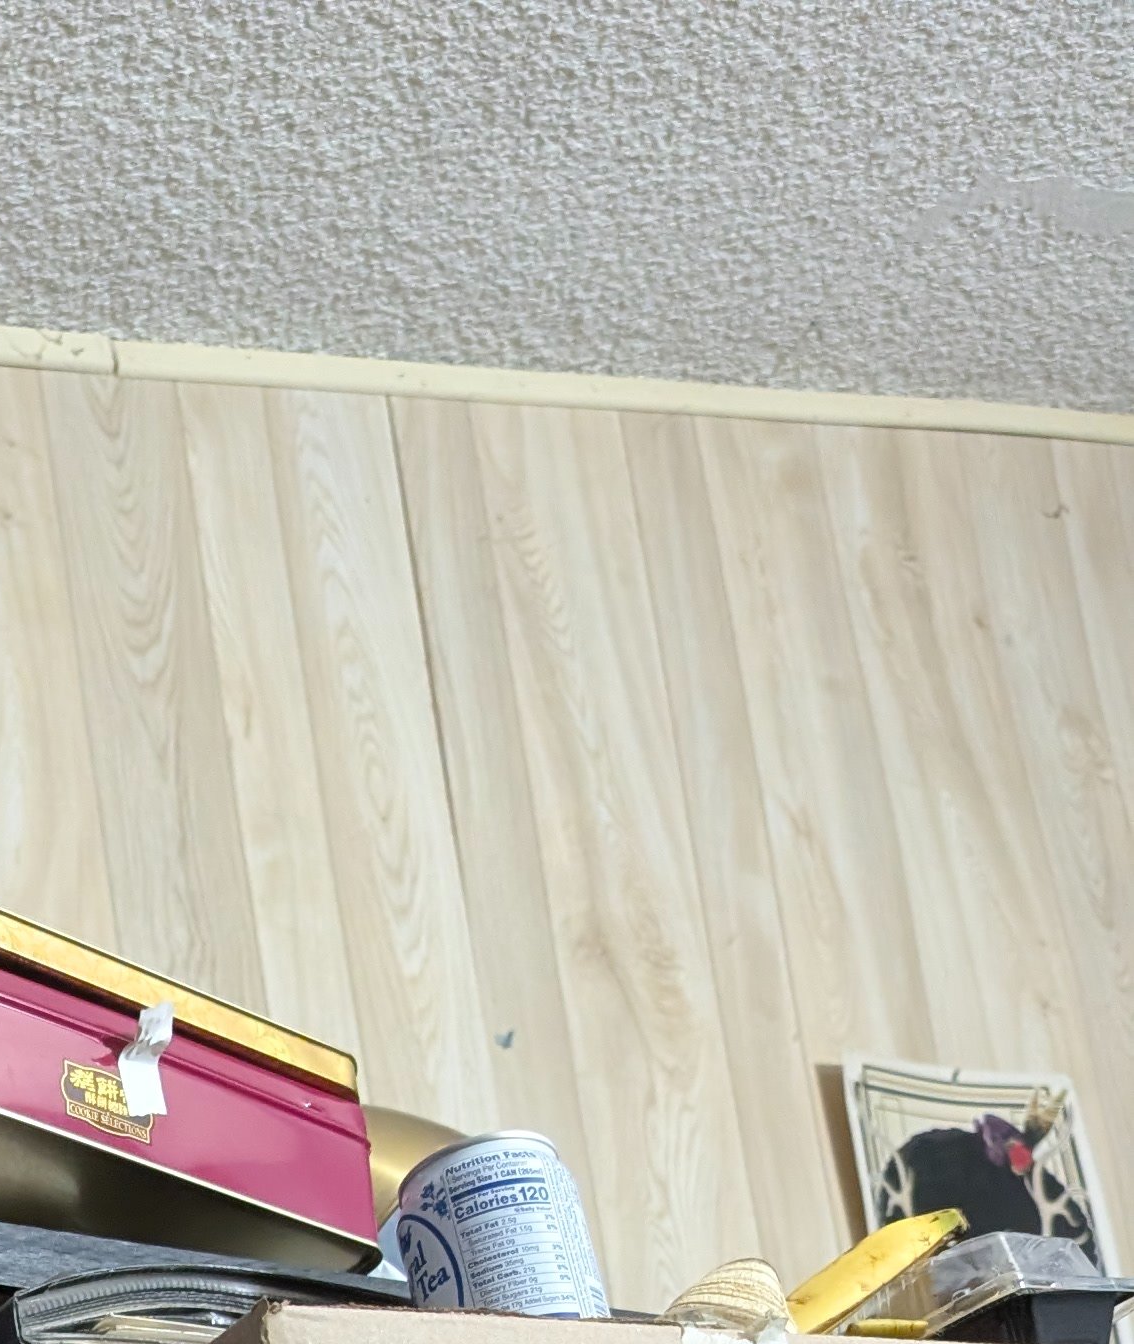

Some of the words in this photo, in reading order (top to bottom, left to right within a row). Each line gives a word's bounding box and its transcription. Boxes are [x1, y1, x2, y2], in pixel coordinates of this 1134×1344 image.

[69, 1103, 99, 1122] COOKIE
[101, 1112, 147, 1139] SELECTIONS
[446, 1154, 500, 1176] Nutrition
[503, 1151, 536, 1159] Facts
[449, 1179, 476, 1194] Serving
[477, 1174, 493, 1185] Size
[500, 1169, 517, 1178] CAN
[454, 1194, 519, 1219] Calories
[519, 1186, 550, 1201] 120
[460, 1225, 483, 1239] Total
[485, 1220, 499, 1230] Fat
[467, 1248, 519, 1269] Cholesterol
[470, 1263, 503, 1279] Sodium
[416, 1267, 450, 1302] Tea
[473, 1275, 496, 1289] Total
